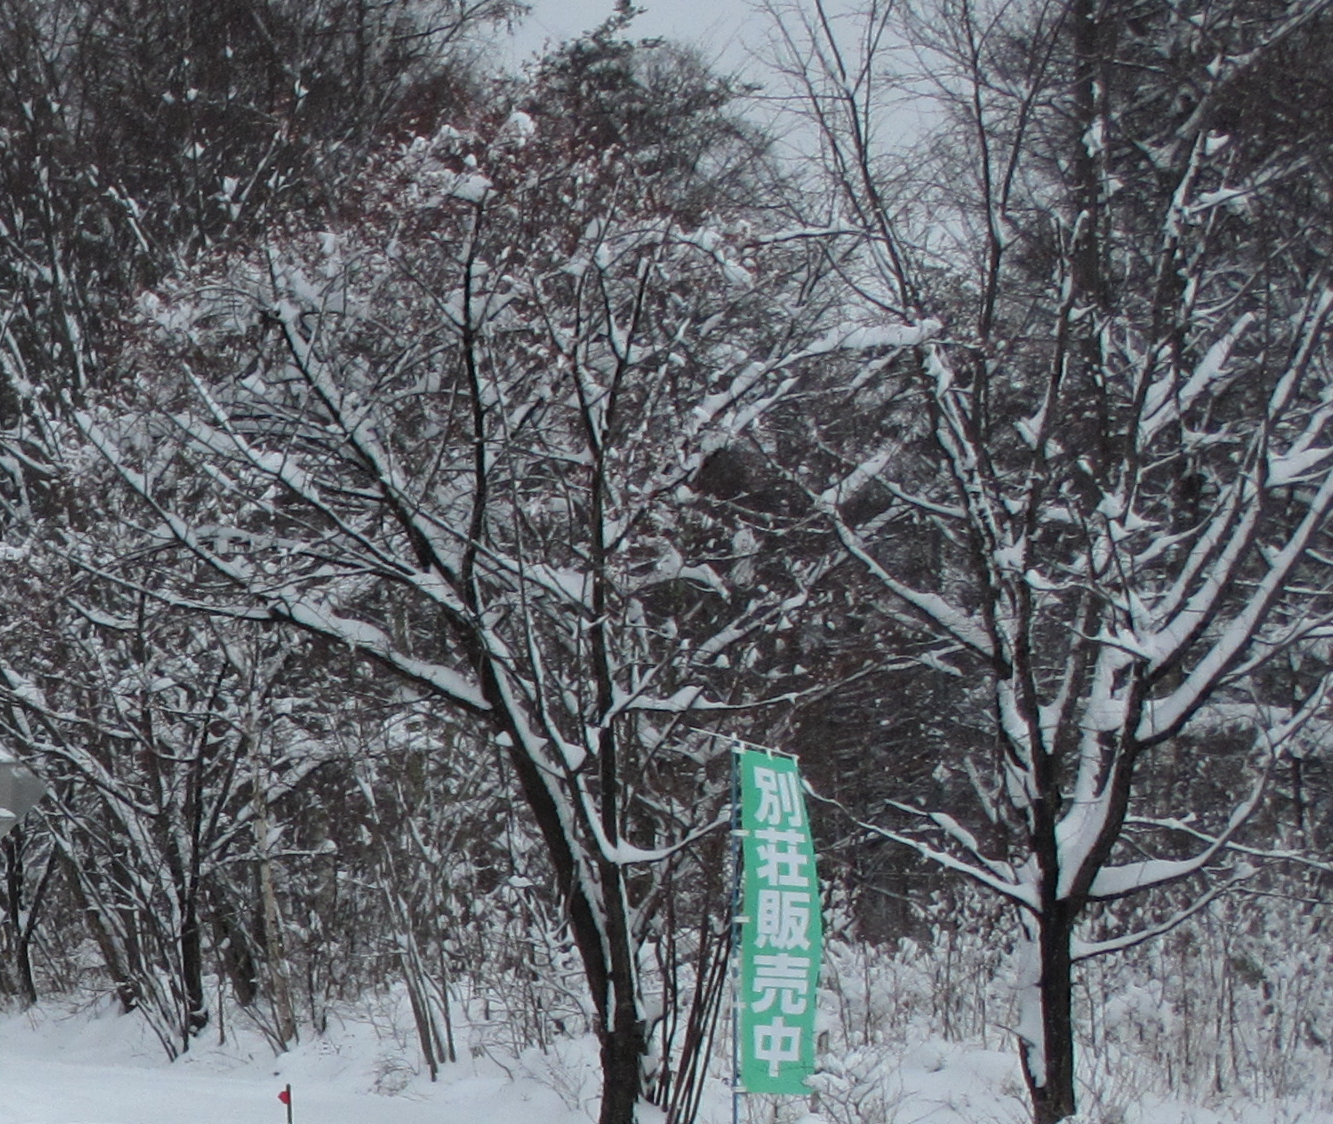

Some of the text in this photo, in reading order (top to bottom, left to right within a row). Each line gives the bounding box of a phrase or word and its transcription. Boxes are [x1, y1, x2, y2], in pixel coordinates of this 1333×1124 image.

[751, 765, 811, 1078] 別荘販売中
